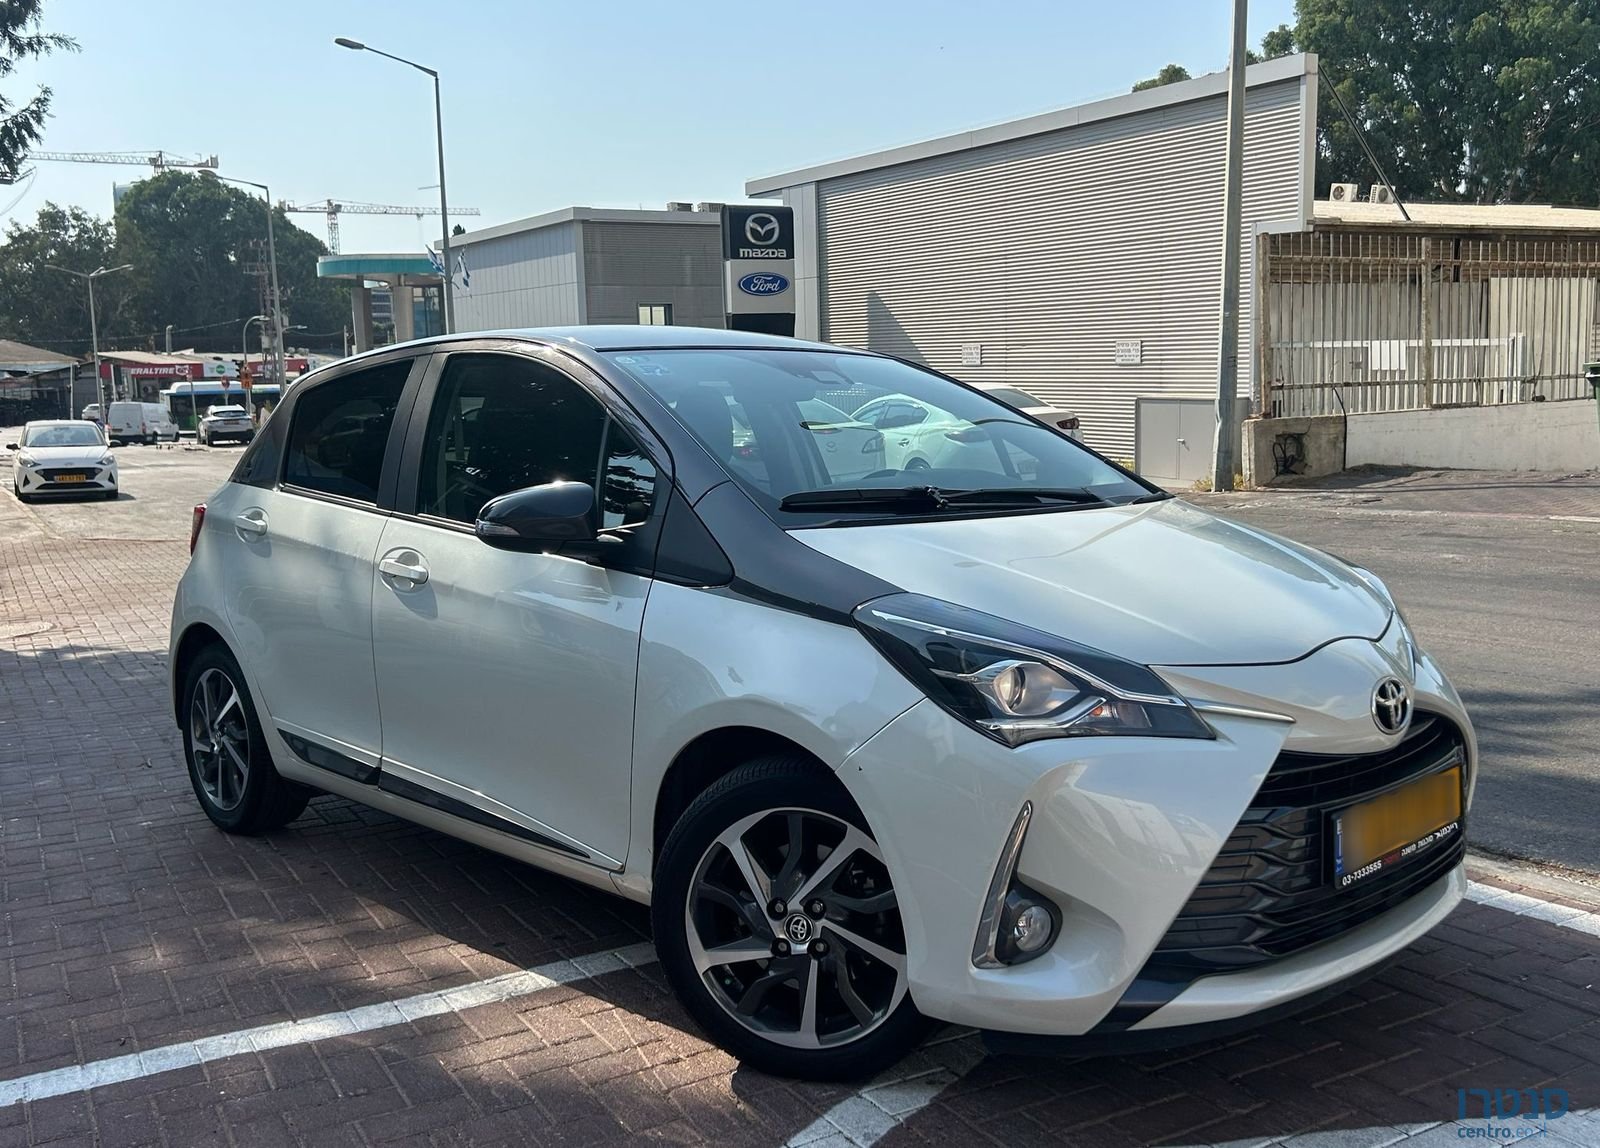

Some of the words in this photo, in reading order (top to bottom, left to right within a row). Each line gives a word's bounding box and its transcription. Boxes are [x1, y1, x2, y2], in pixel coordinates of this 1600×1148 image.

[751, 276, 780, 291] Ford
[130, 366, 175, 375] ERALTIRE
[1341, 860, 1382, 886] 03-7333555
